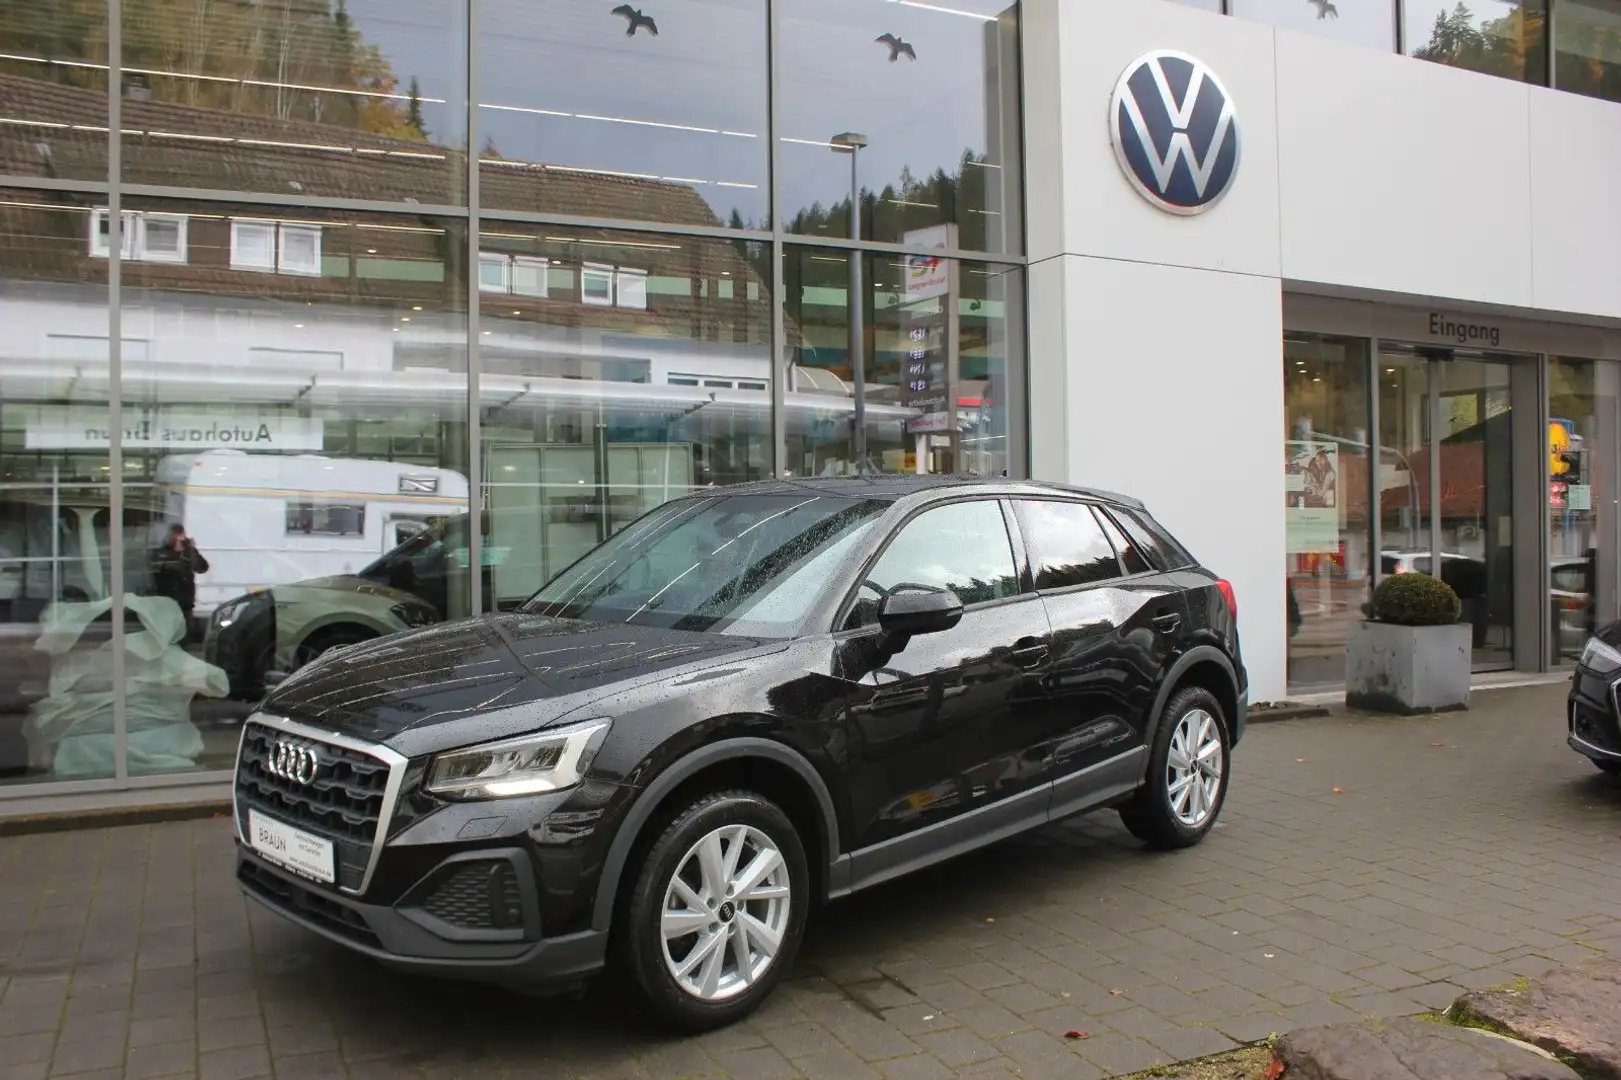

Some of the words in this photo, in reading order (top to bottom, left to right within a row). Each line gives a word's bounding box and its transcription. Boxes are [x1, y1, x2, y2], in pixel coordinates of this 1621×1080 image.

[1115, 54, 1238, 200] VW
[1429, 313, 1500, 347] Eingang
[258, 826, 287, 853] BRAUN
